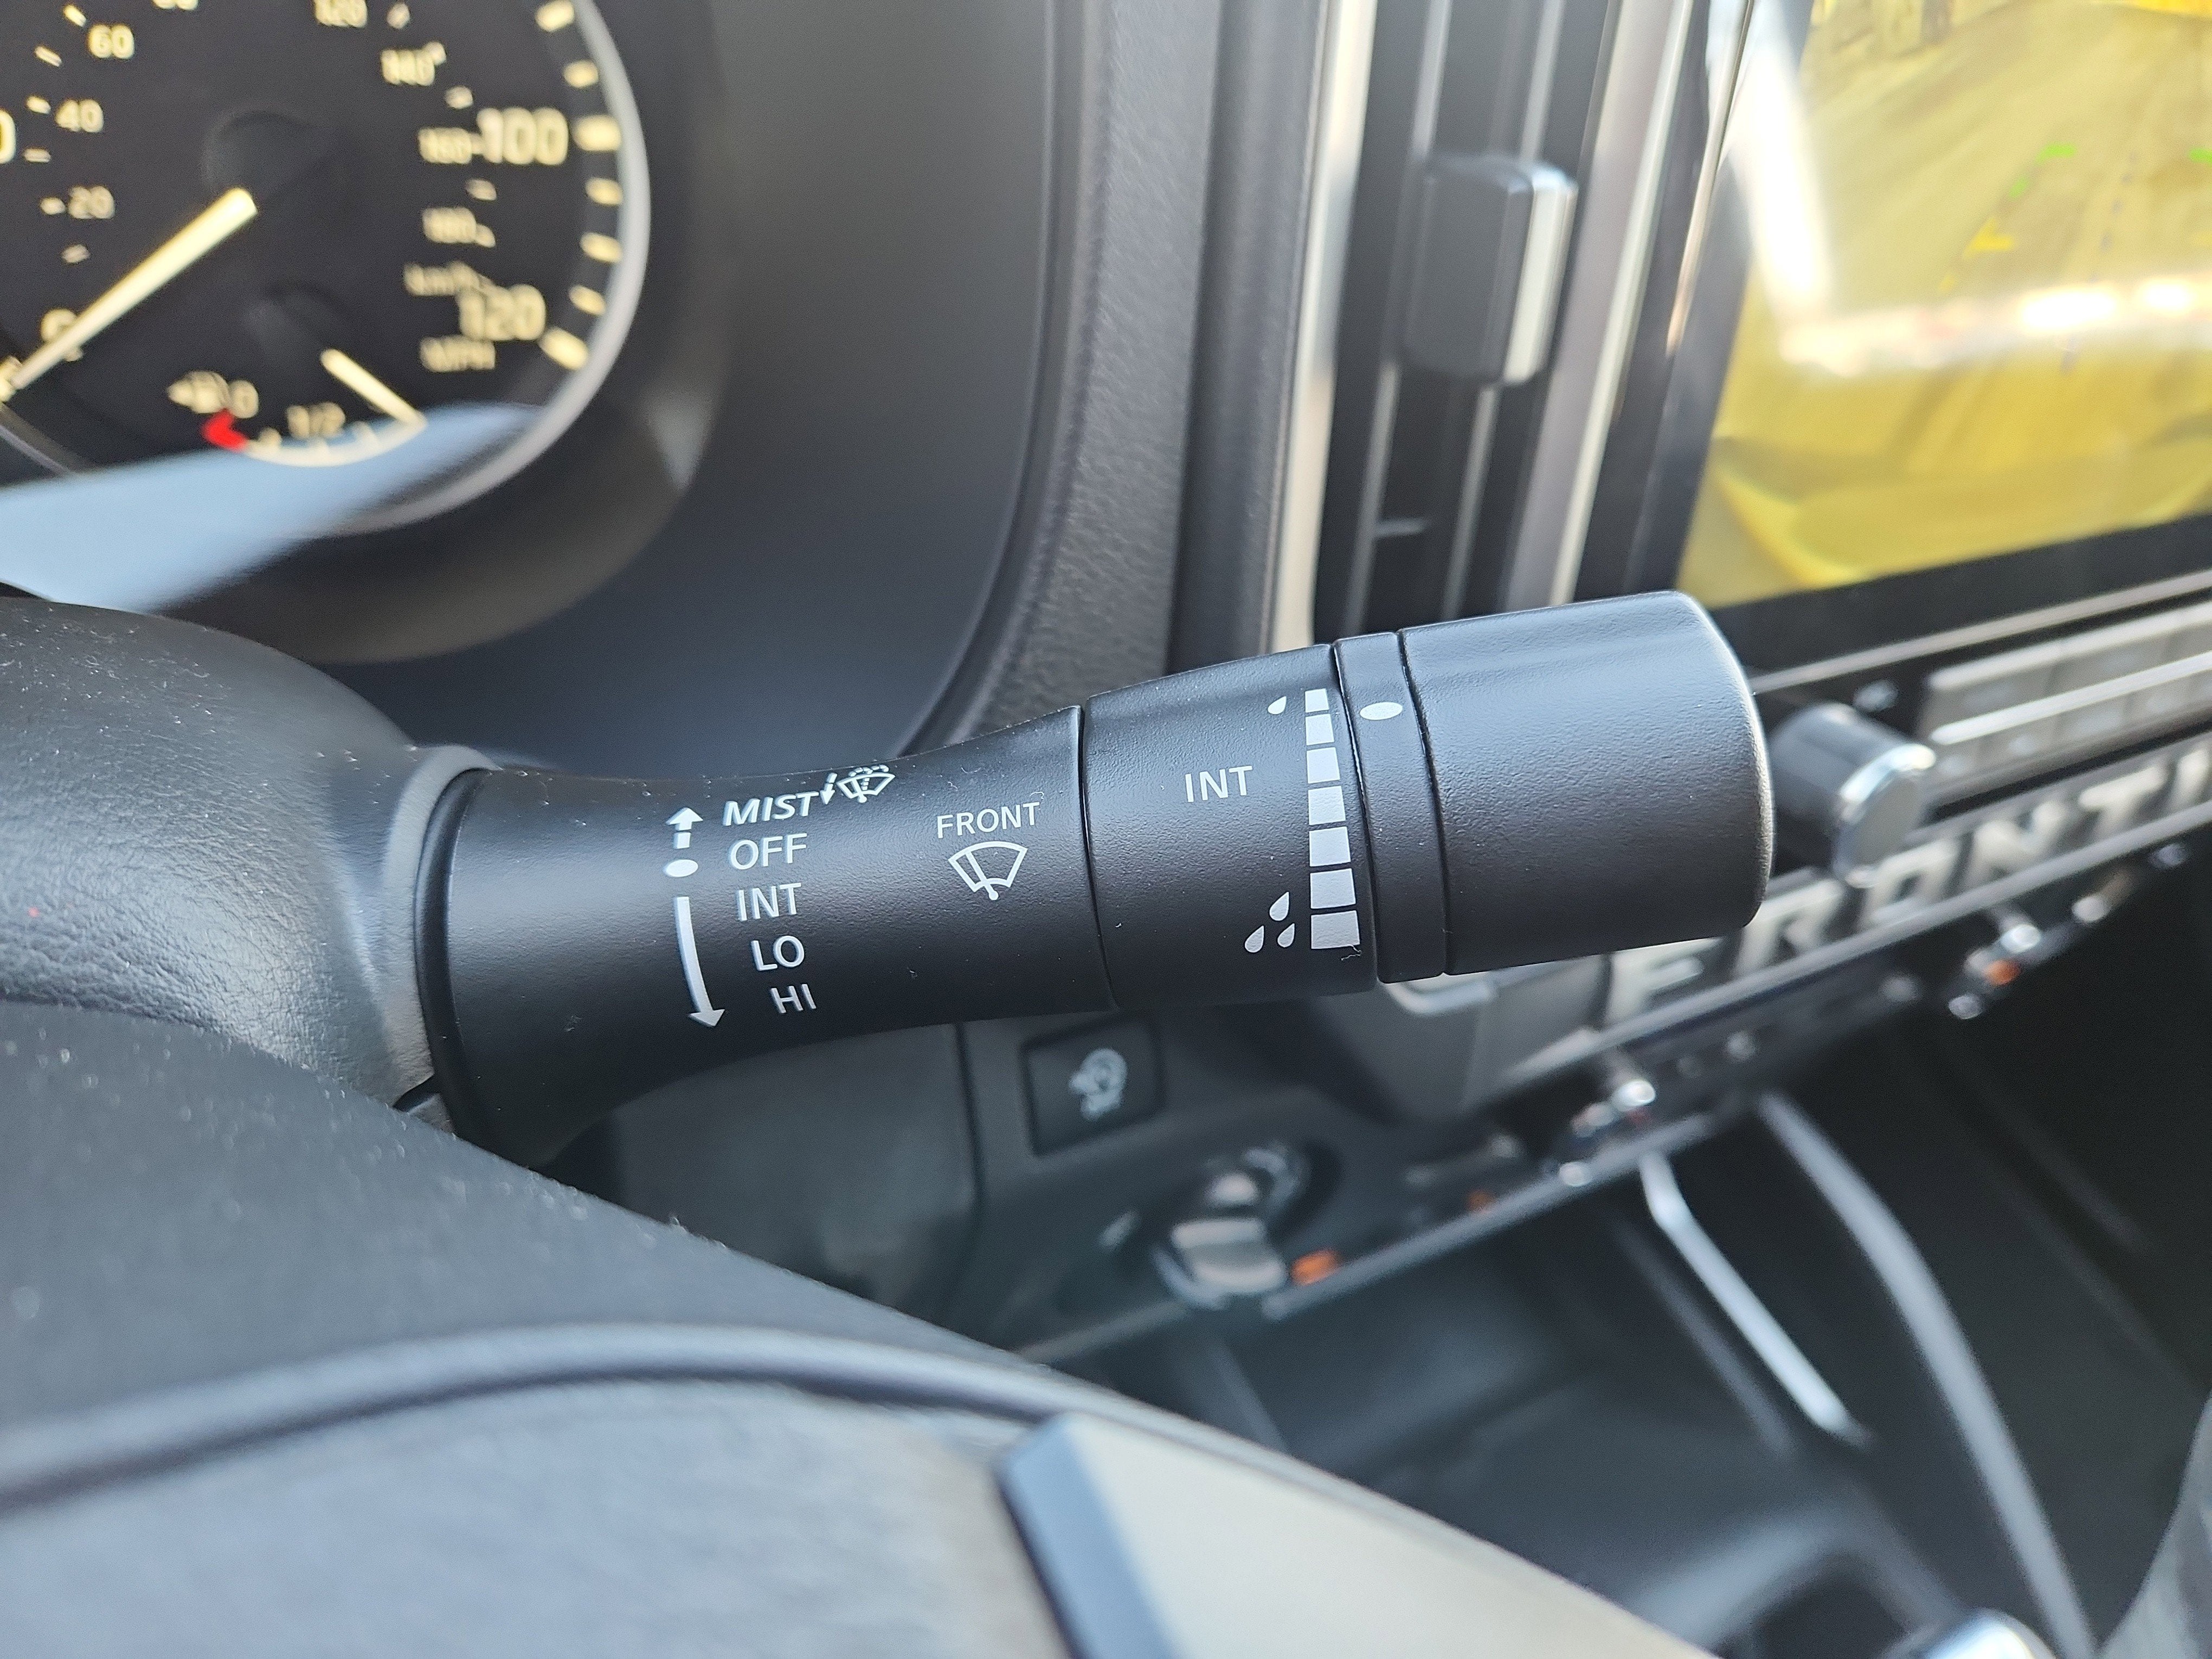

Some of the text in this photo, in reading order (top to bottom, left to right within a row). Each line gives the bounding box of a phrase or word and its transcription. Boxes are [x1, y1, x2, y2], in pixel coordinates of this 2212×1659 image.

[89, 24, 134, 59] 60
[55, 99, 104, 133] 40
[476, 107, 568, 165] 100
[1185, 765, 1252, 802] INT
[722, 791, 819, 827] MIST
[937, 802, 1040, 839] FRONT
[729, 832, 808, 870] OFF
[738, 883, 802, 921] INT
[750, 935, 806, 972] LO
[770, 983, 817, 1014] HI
